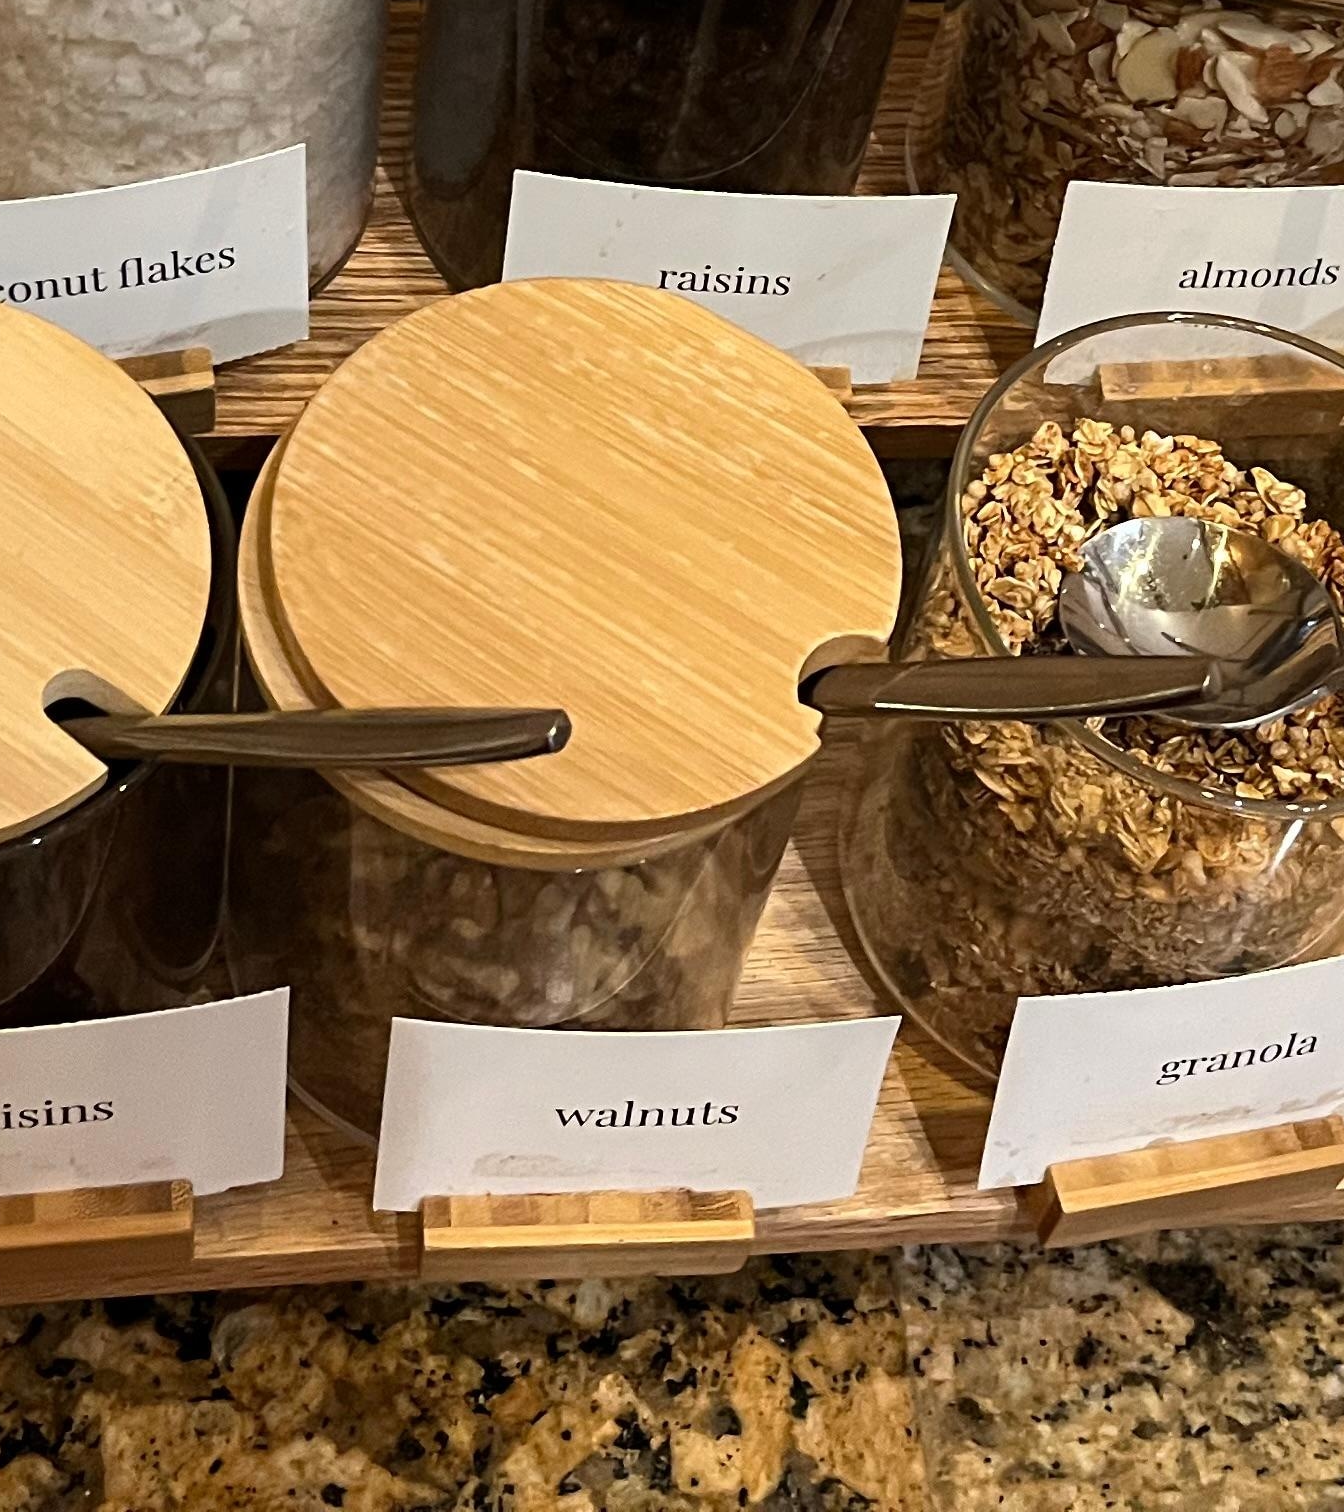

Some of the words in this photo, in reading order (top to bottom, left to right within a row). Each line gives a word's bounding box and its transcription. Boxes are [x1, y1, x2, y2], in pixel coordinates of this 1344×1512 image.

[119, 245, 236, 289] flakes
[657, 264, 791, 296] raisins
[1178, 257, 1341, 289] almonds
[1155, 1032, 1319, 1086] granola
[555, 1100, 739, 1128] walnuts
